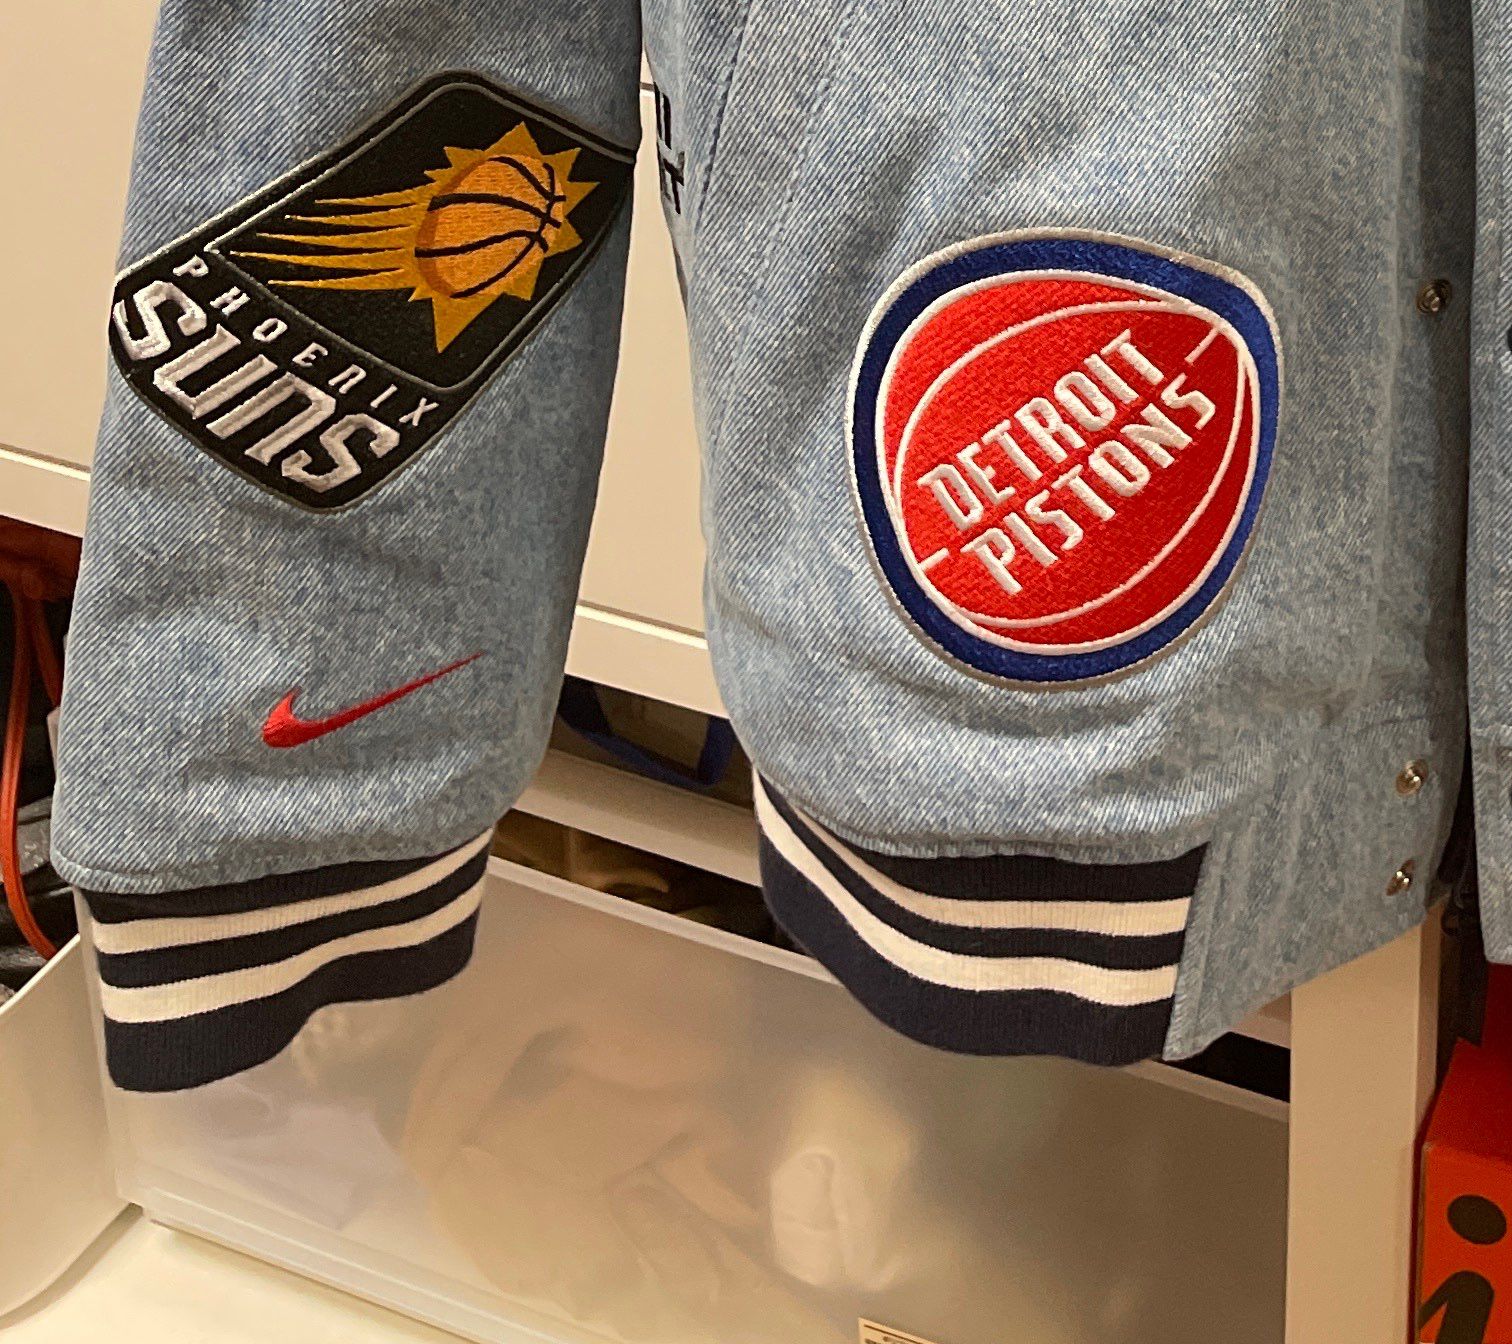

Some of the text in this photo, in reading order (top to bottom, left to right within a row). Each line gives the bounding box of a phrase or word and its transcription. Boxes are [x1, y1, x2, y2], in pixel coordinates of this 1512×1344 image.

[111, 279, 401, 494] SUNS
[172, 254, 441, 427] PHOENIX
[917, 328, 1165, 531] DETROIT
[960, 373, 1217, 596] PISTONS
